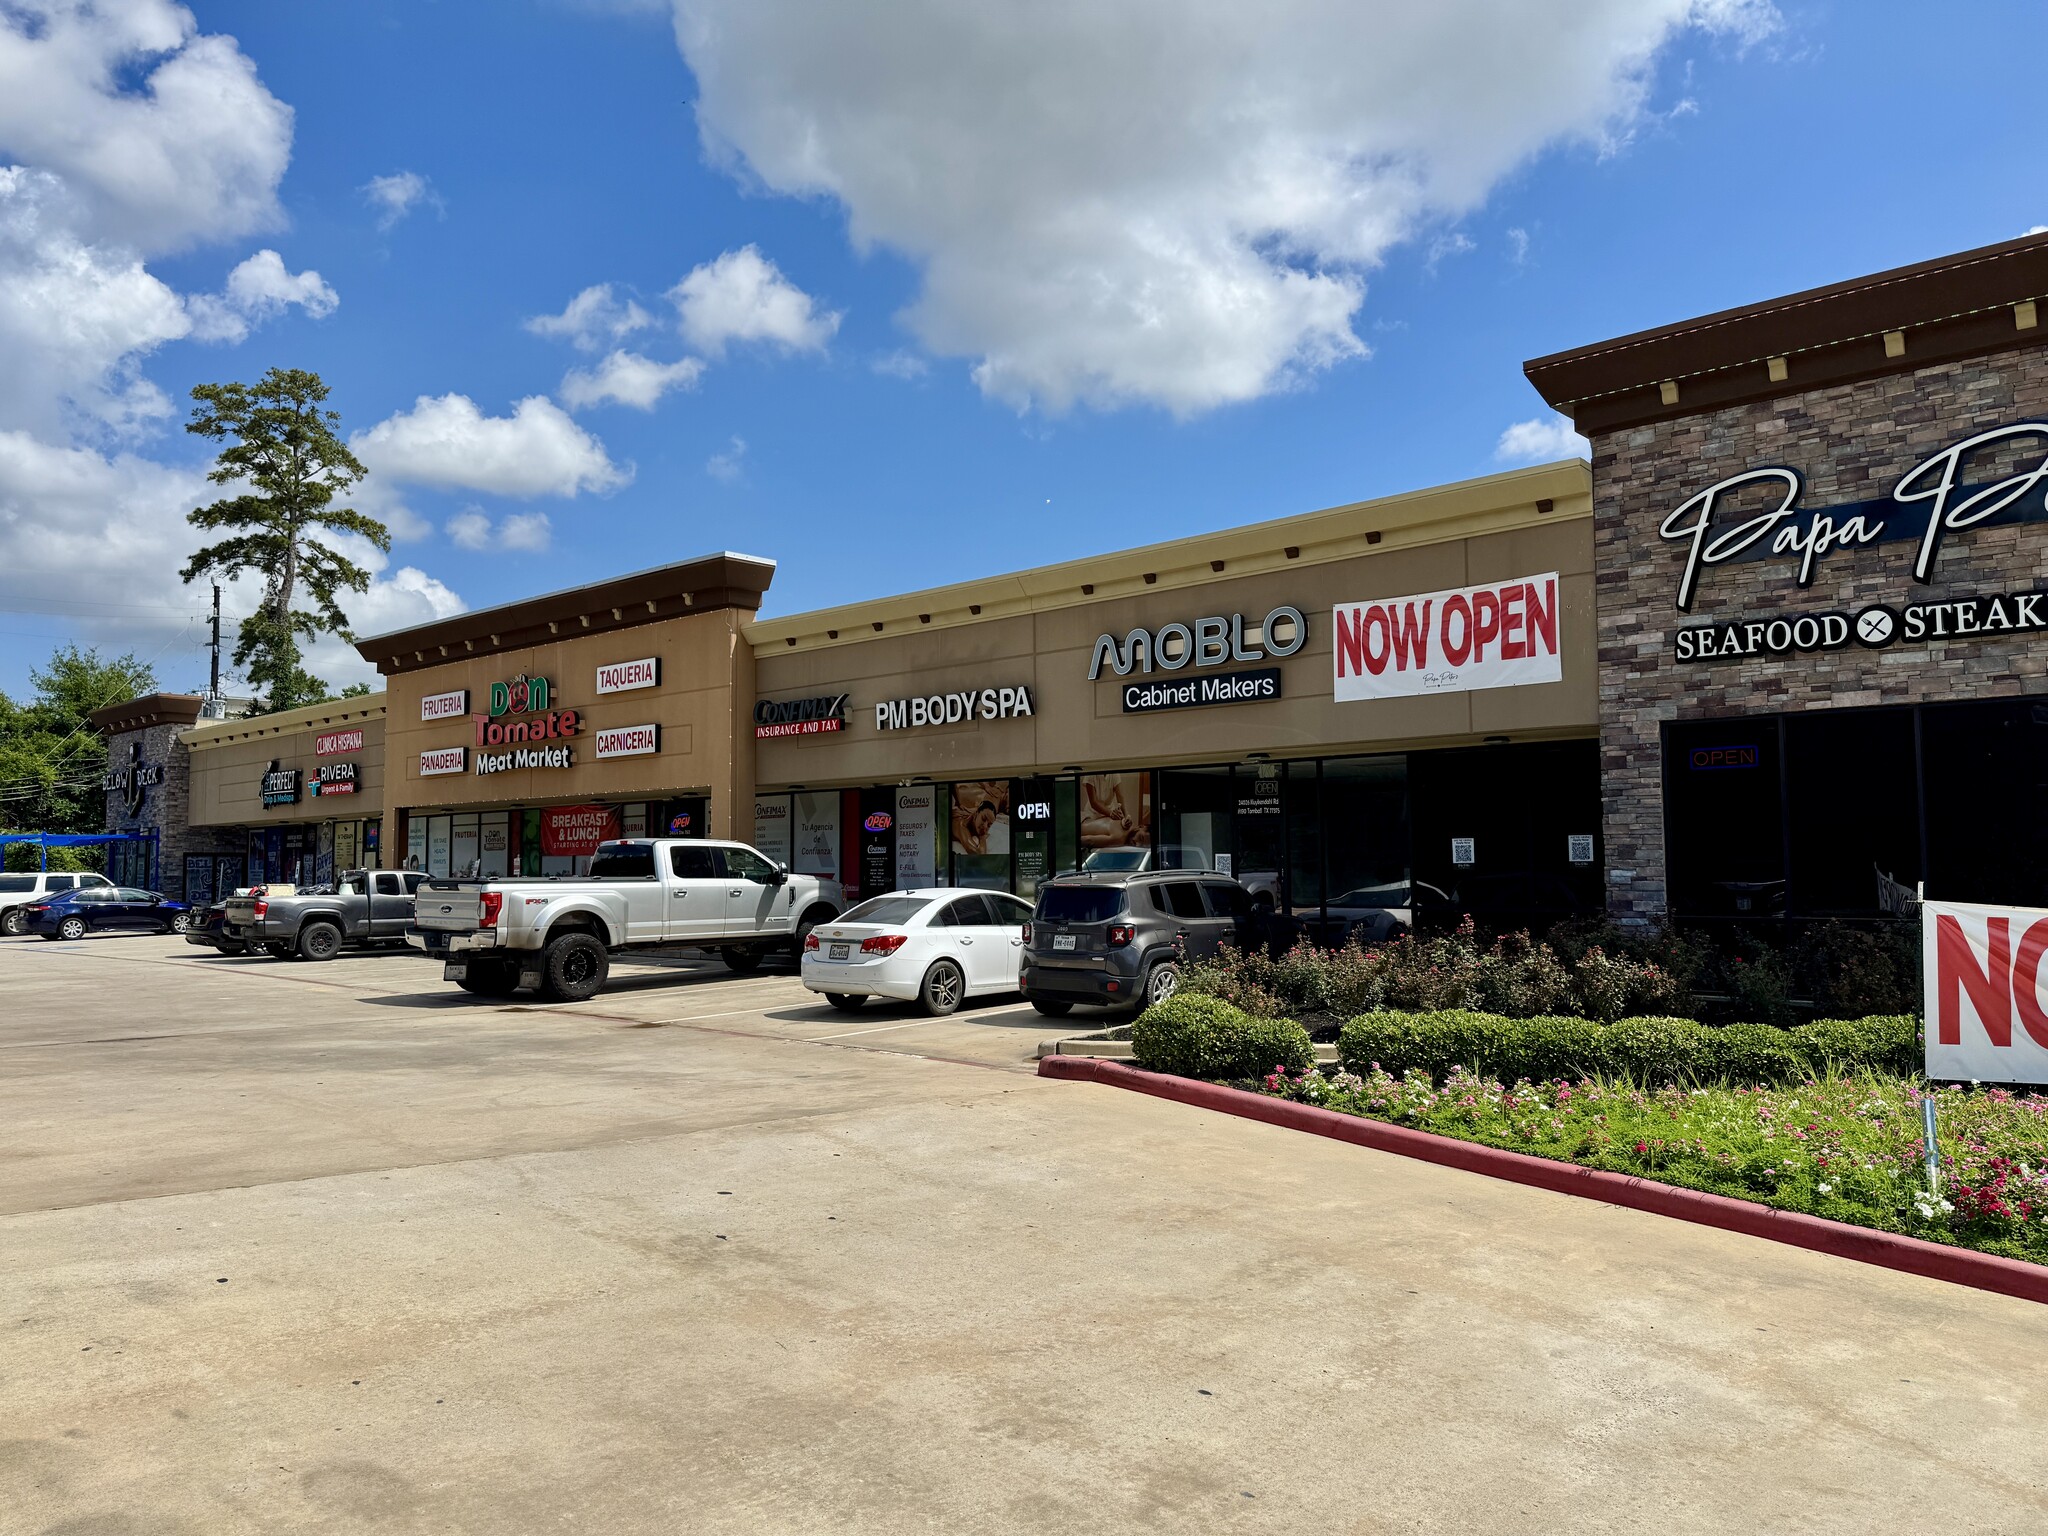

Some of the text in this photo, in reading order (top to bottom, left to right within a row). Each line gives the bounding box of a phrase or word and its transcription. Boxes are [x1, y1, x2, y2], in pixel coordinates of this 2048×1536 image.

[1660, 428, 2048, 608] Papa P
[1337, 579, 1557, 678] NOW OPEN
[1677, 594, 2048, 660] SEAFOOD STEAK
[1088, 606, 1306, 680] MOBLO
[600, 663, 653, 689] TAQUERIA
[490, 675, 548, 717] Don
[1126, 677, 1274, 709] Cabinet Makers
[424, 696, 462, 716] FRUTERIA
[754, 693, 849, 724] CONFIMAX
[876, 686, 1032, 730] PM BODY SPA
[472, 711, 576, 747] Tomate
[757, 719, 838, 738] INSURANCE AND TAX
[316, 732, 363, 755] CLINICA HISPANA
[597, 730, 654, 754] CARNICERIA
[421, 752, 462, 772] PANADERIA
[476, 745, 569, 776] Meat Market
[1694, 749, 1754, 767] OPEN
[102, 767, 159, 791] BELOW DECK
[269, 770, 296, 792] PERFECT
[320, 763, 355, 782] RIVERA
[1256, 783, 1278, 794] OPEN
[552, 812, 609, 828] BREAKFAST
[1018, 802, 1051, 820] OPEN
[622, 823, 645, 834] QUERIA
[672, 816, 692, 829] OPEN
[802, 822, 834, 833] Tu Agencia
[867, 815, 892, 829] OPEN
[899, 822, 923, 831] SEGUROS
[455, 831, 477, 839] FRUTERIA
[559, 827, 600, 841] & LUNCH
[814, 835, 821, 844] de
[553, 841, 580, 849] STARTING
